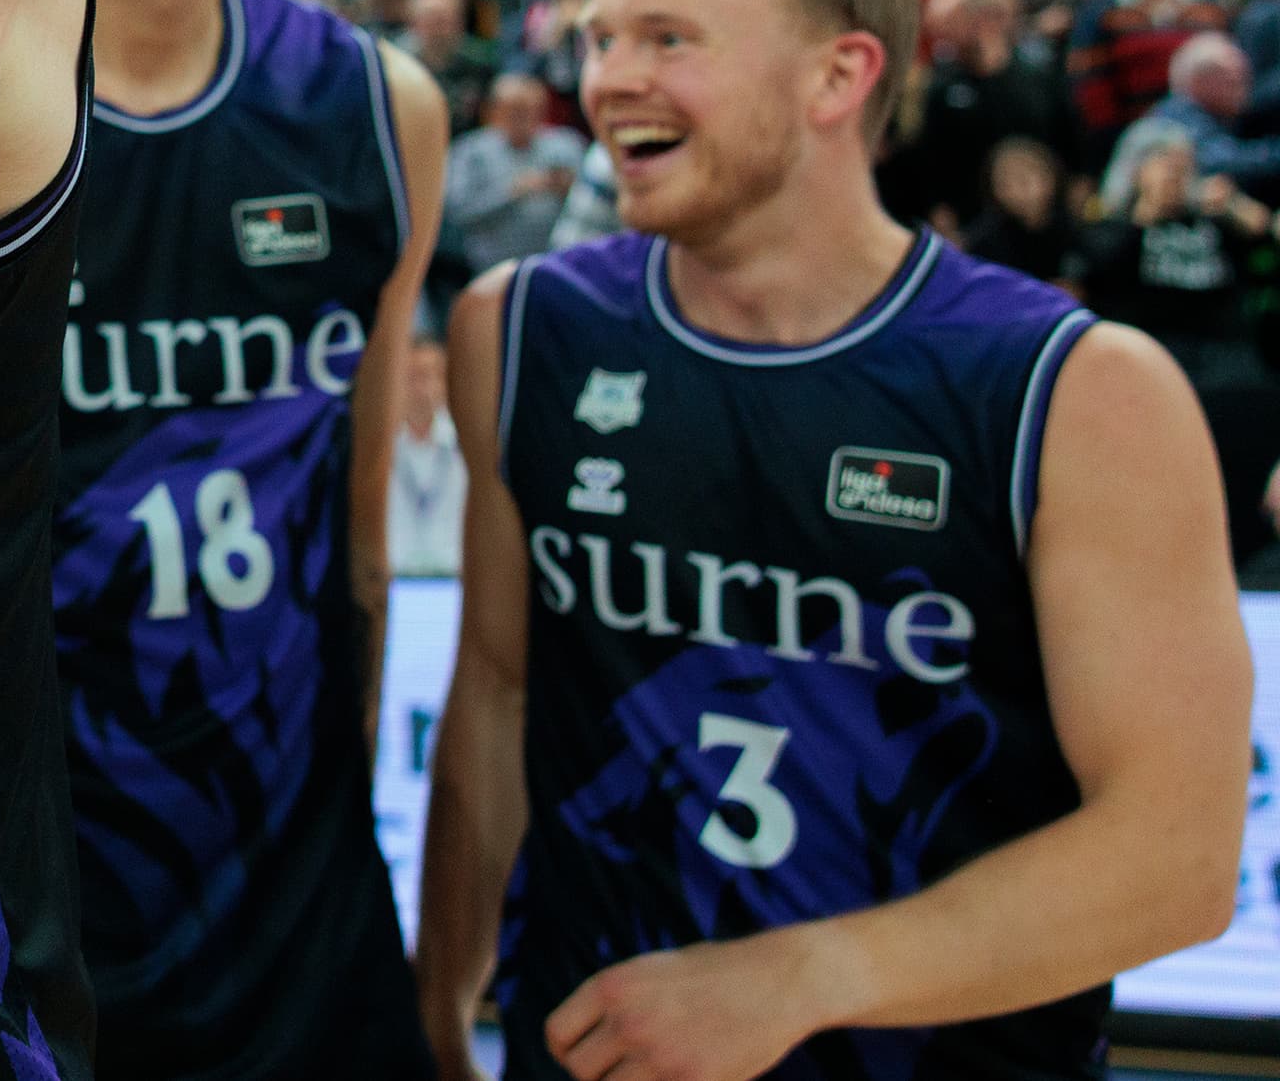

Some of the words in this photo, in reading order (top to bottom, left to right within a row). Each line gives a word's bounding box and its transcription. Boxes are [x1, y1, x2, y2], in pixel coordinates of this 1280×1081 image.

[128, 469, 275, 619] 18
[530, 524, 975, 683] surne
[697, 711, 799, 870] 3
